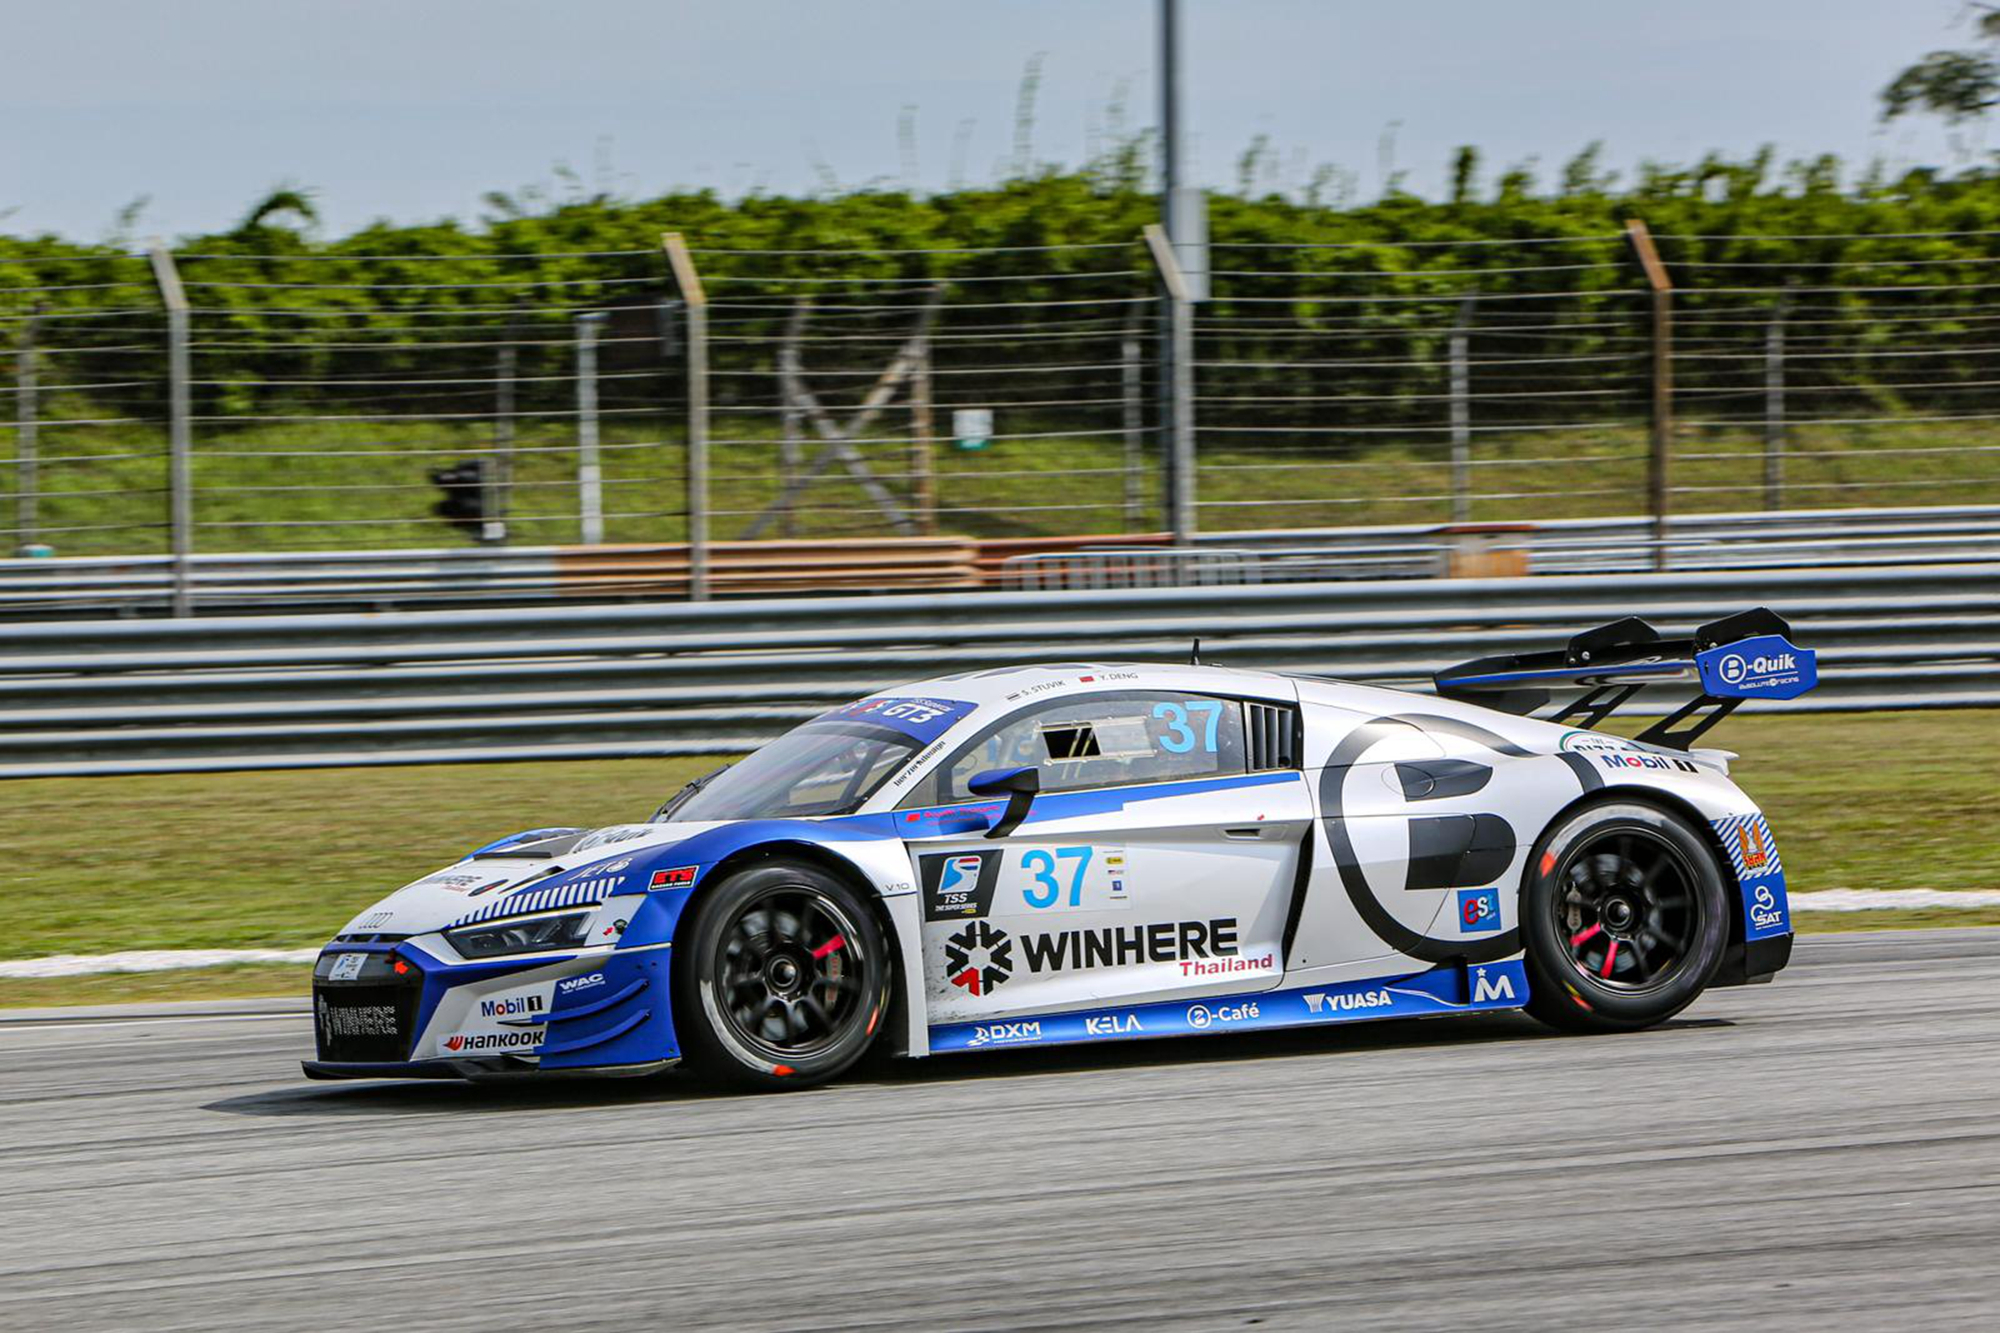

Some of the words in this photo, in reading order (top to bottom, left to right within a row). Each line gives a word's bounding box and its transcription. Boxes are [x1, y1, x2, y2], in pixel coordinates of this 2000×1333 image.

[1110, 672, 1139, 681] DENG
[1033, 680, 1067, 694] STUVIK
[882, 702, 946, 724] GT3
[1153, 700, 1223, 754] 37
[1600, 754, 1671, 771] Mobil
[1020, 845, 1094, 909] 37
[944, 893, 969, 904] TSS
[1020, 918, 1239, 973] WINHERE
[1180, 954, 1273, 977] Thailand
[559, 973, 604, 990] WAC
[481, 997, 526, 1017] Mobil
[1325, 990, 1393, 1011] YUASA
[990, 1022, 1042, 1039] DXM
[1085, 1014, 1144, 1035] KELA
